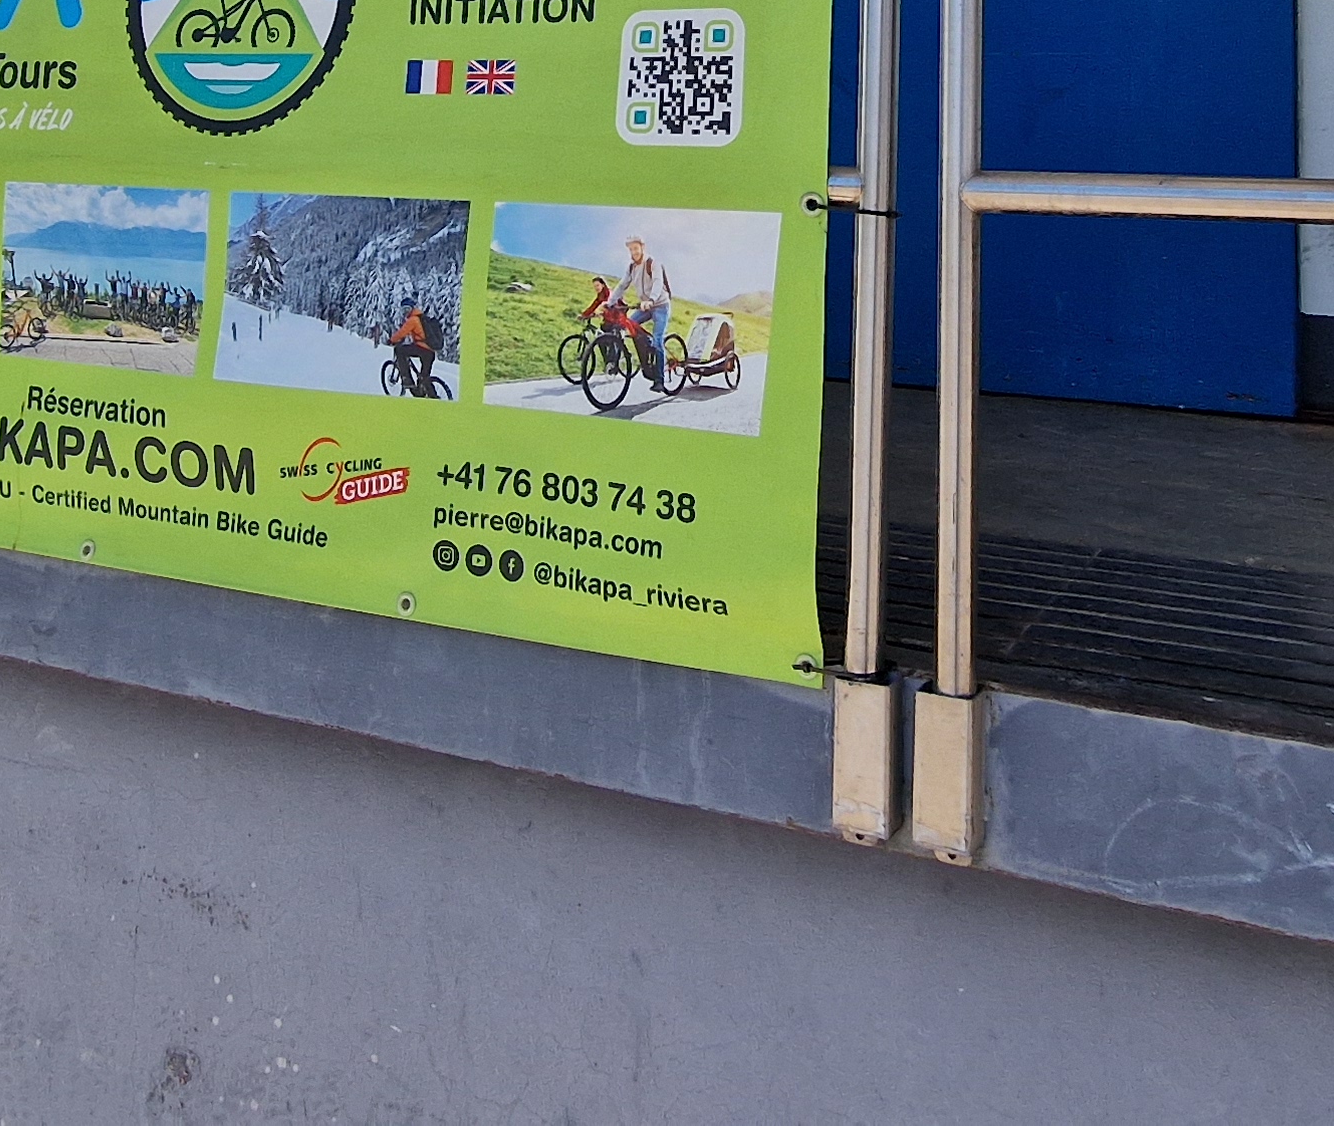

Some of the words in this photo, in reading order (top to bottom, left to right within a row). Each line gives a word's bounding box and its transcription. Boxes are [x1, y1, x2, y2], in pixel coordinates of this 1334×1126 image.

[9, 101, 29, 130] À
[29, 101, 74, 131] VÉLO
[26, 386, 166, 428] Réservation
[280, 462, 318, 479] SWISS
[326, 457, 382, 476] CYCLING
[341, 470, 404, 501] GUIDE
[437, 461, 485, 491] +41
[495, 466, 532, 497] 76
[541, 472, 598, 508] 803
[608, 480, 646, 516] 74
[656, 489, 696, 523] 38
[31, 484, 112, 514] Certified
[118, 496, 209, 528] Mountain
[216, 510, 260, 538] Bike
[267, 519, 328, 548] Guide
[433, 503, 663, 559] pierre@bikapa.com
[534, 562, 729, 616] @bikapa_riviera
